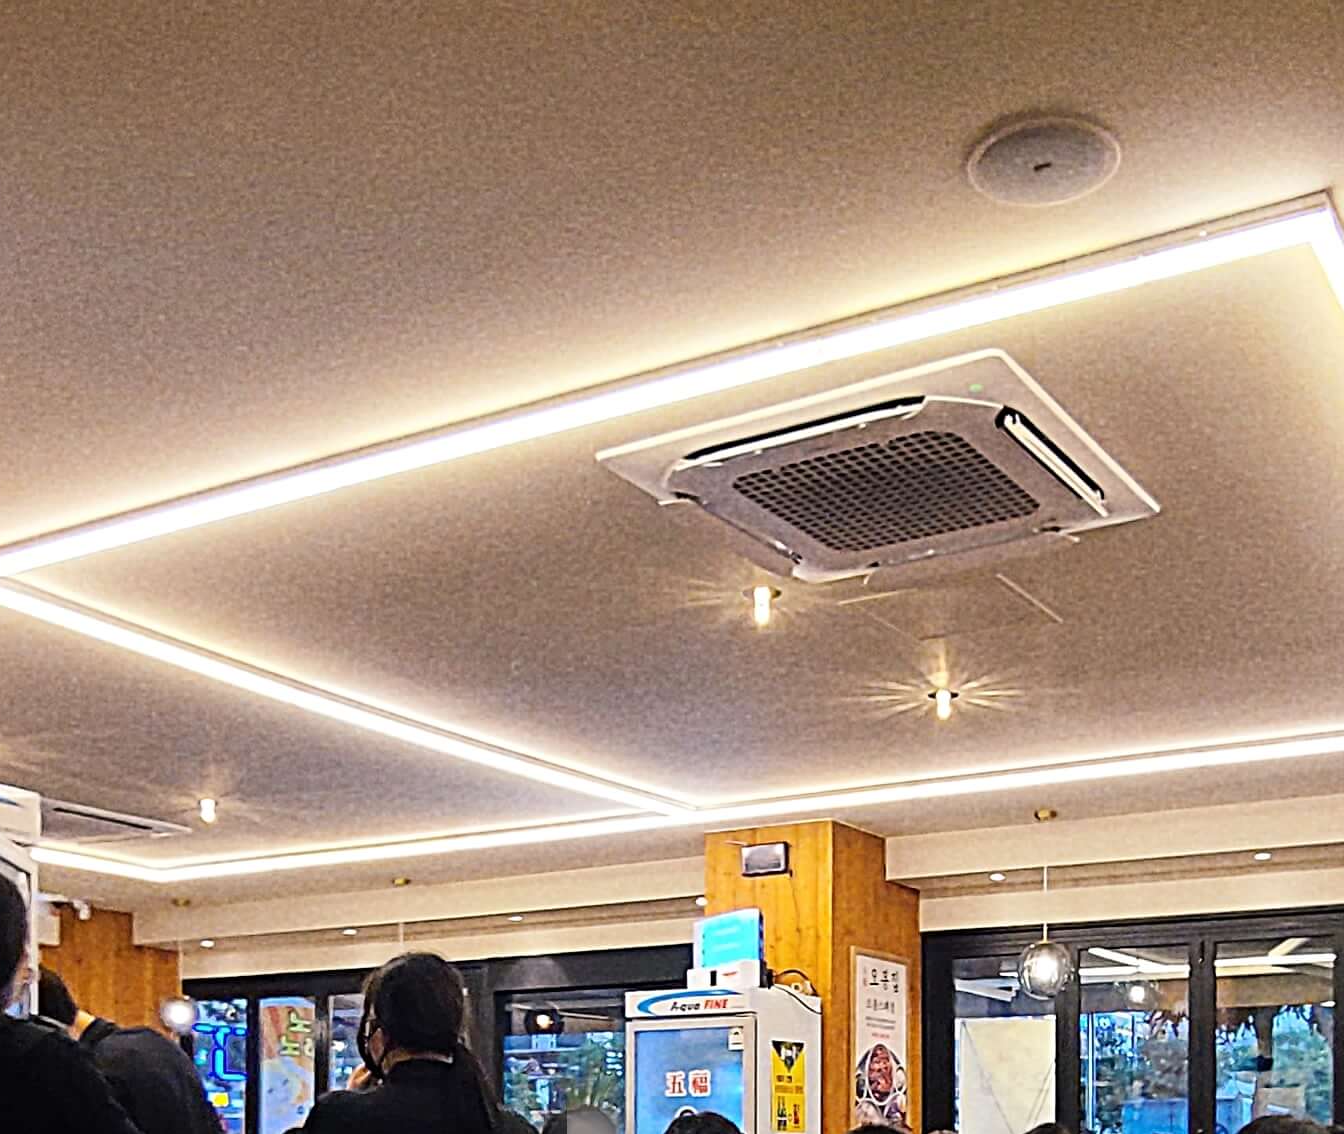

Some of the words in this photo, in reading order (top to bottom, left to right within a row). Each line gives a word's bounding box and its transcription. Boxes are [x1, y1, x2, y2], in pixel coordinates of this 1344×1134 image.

[869, 968, 899, 994] 오봉집
[670, 1001, 701, 1012] Aqua
[703, 999, 729, 1010] FINE
